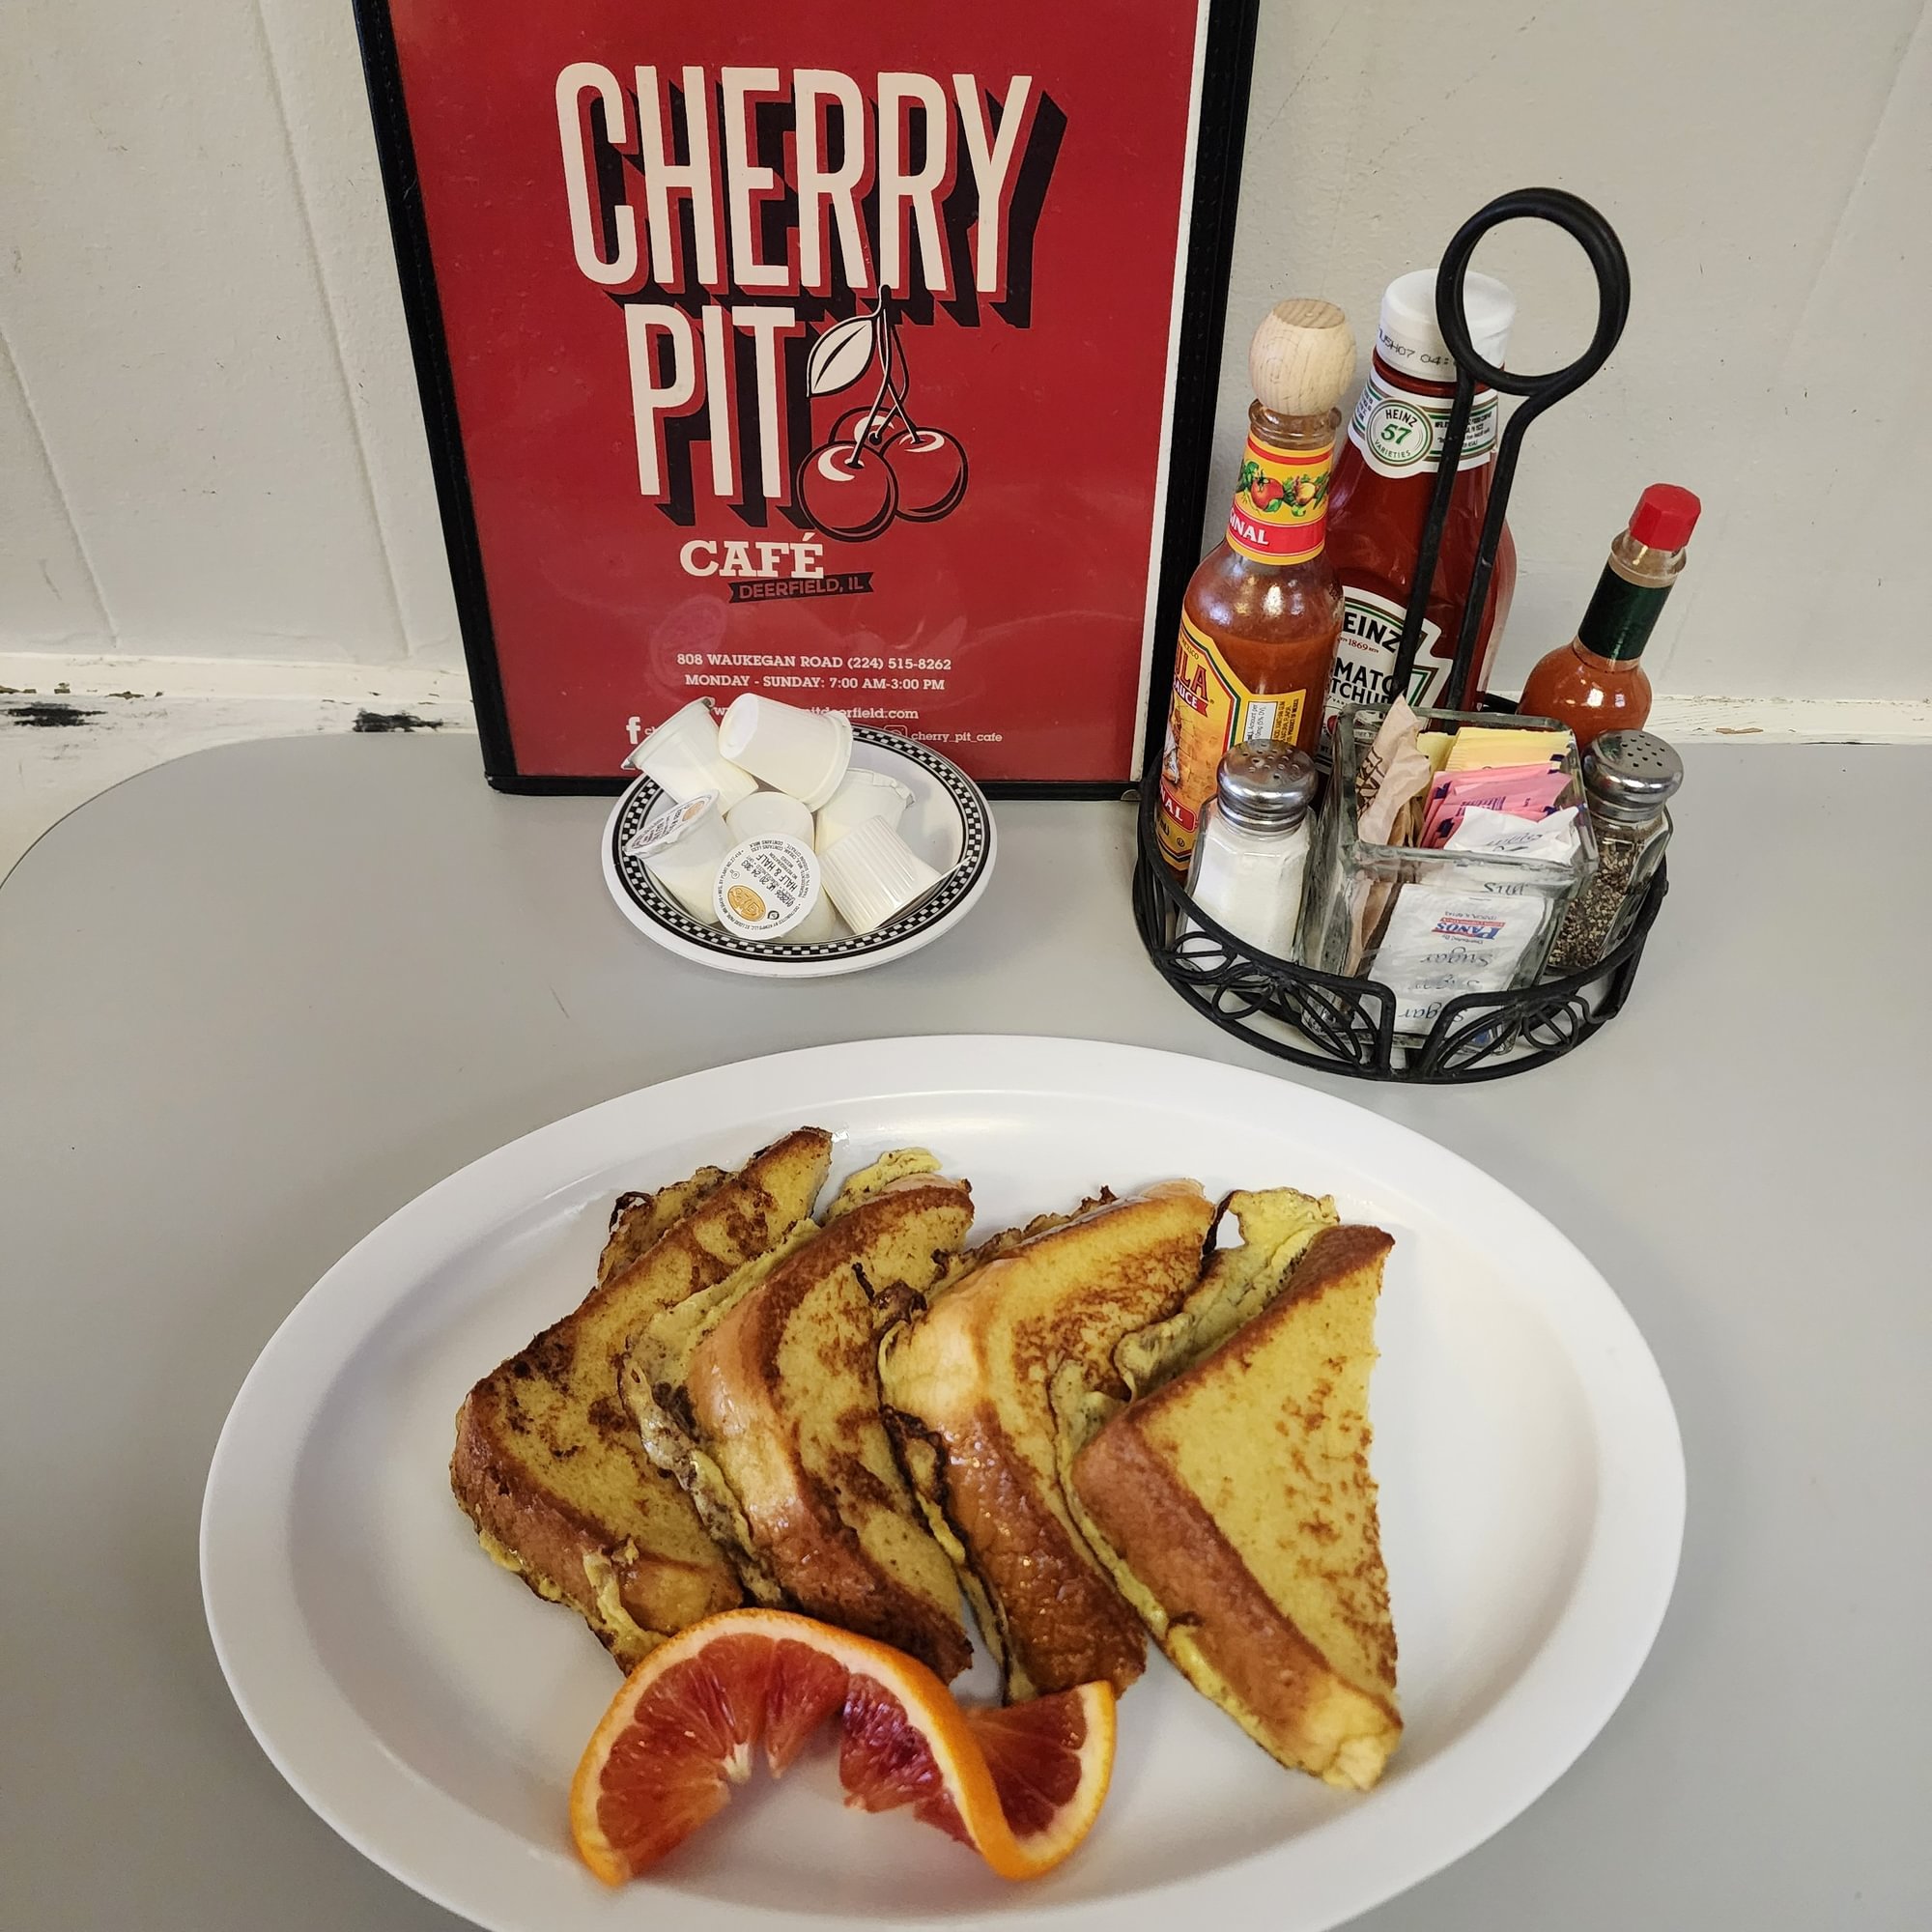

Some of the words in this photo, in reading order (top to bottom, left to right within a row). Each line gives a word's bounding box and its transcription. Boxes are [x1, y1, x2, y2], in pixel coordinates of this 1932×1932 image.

[555, 62, 1033, 292] CHERRY
[624, 304, 796, 498] PIT
[1385, 409, 1418, 428] HEINZ
[1381, 424, 1412, 445] 57
[1375, 439, 1411, 459] VARIETIES
[1230, 507, 1269, 546] INAL
[679, 532, 824, 580] CAFÉ
[739, 579, 844, 600] DEERFIELD,
[848, 577, 865, 590] IL
[1343, 611, 1403, 654] EINZ
[1348, 638, 1369, 651] 1869
[677, 653, 703, 666] 808
[707, 653, 796, 668] WAUKEGAN
[800, 656, 843, 668] ROAD
[847, 657, 884, 670] (224)
[888, 658, 952, 670] 515-8262
[685, 674, 751, 687] MONDAY
[763, 676, 825, 689] SUNDAY:
[829, 677, 859, 689] 7:00
[862, 678, 919, 690] AM-3:00
[923, 679, 946, 691] PM
[1334, 657, 1395, 696] MATO
[1174, 675, 1198, 709] AUCE
[1331, 678, 1390, 704] TCHUP
[911, 731, 1003, 743] cherry_pit_cafe
[755, 853, 777, 872] HALF
[774, 868, 782, 877] &
[779, 874, 799, 893] HALF
[1436, 922, 1503, 941] PANOS
[1399, 1001, 1467, 1022] Sgar
